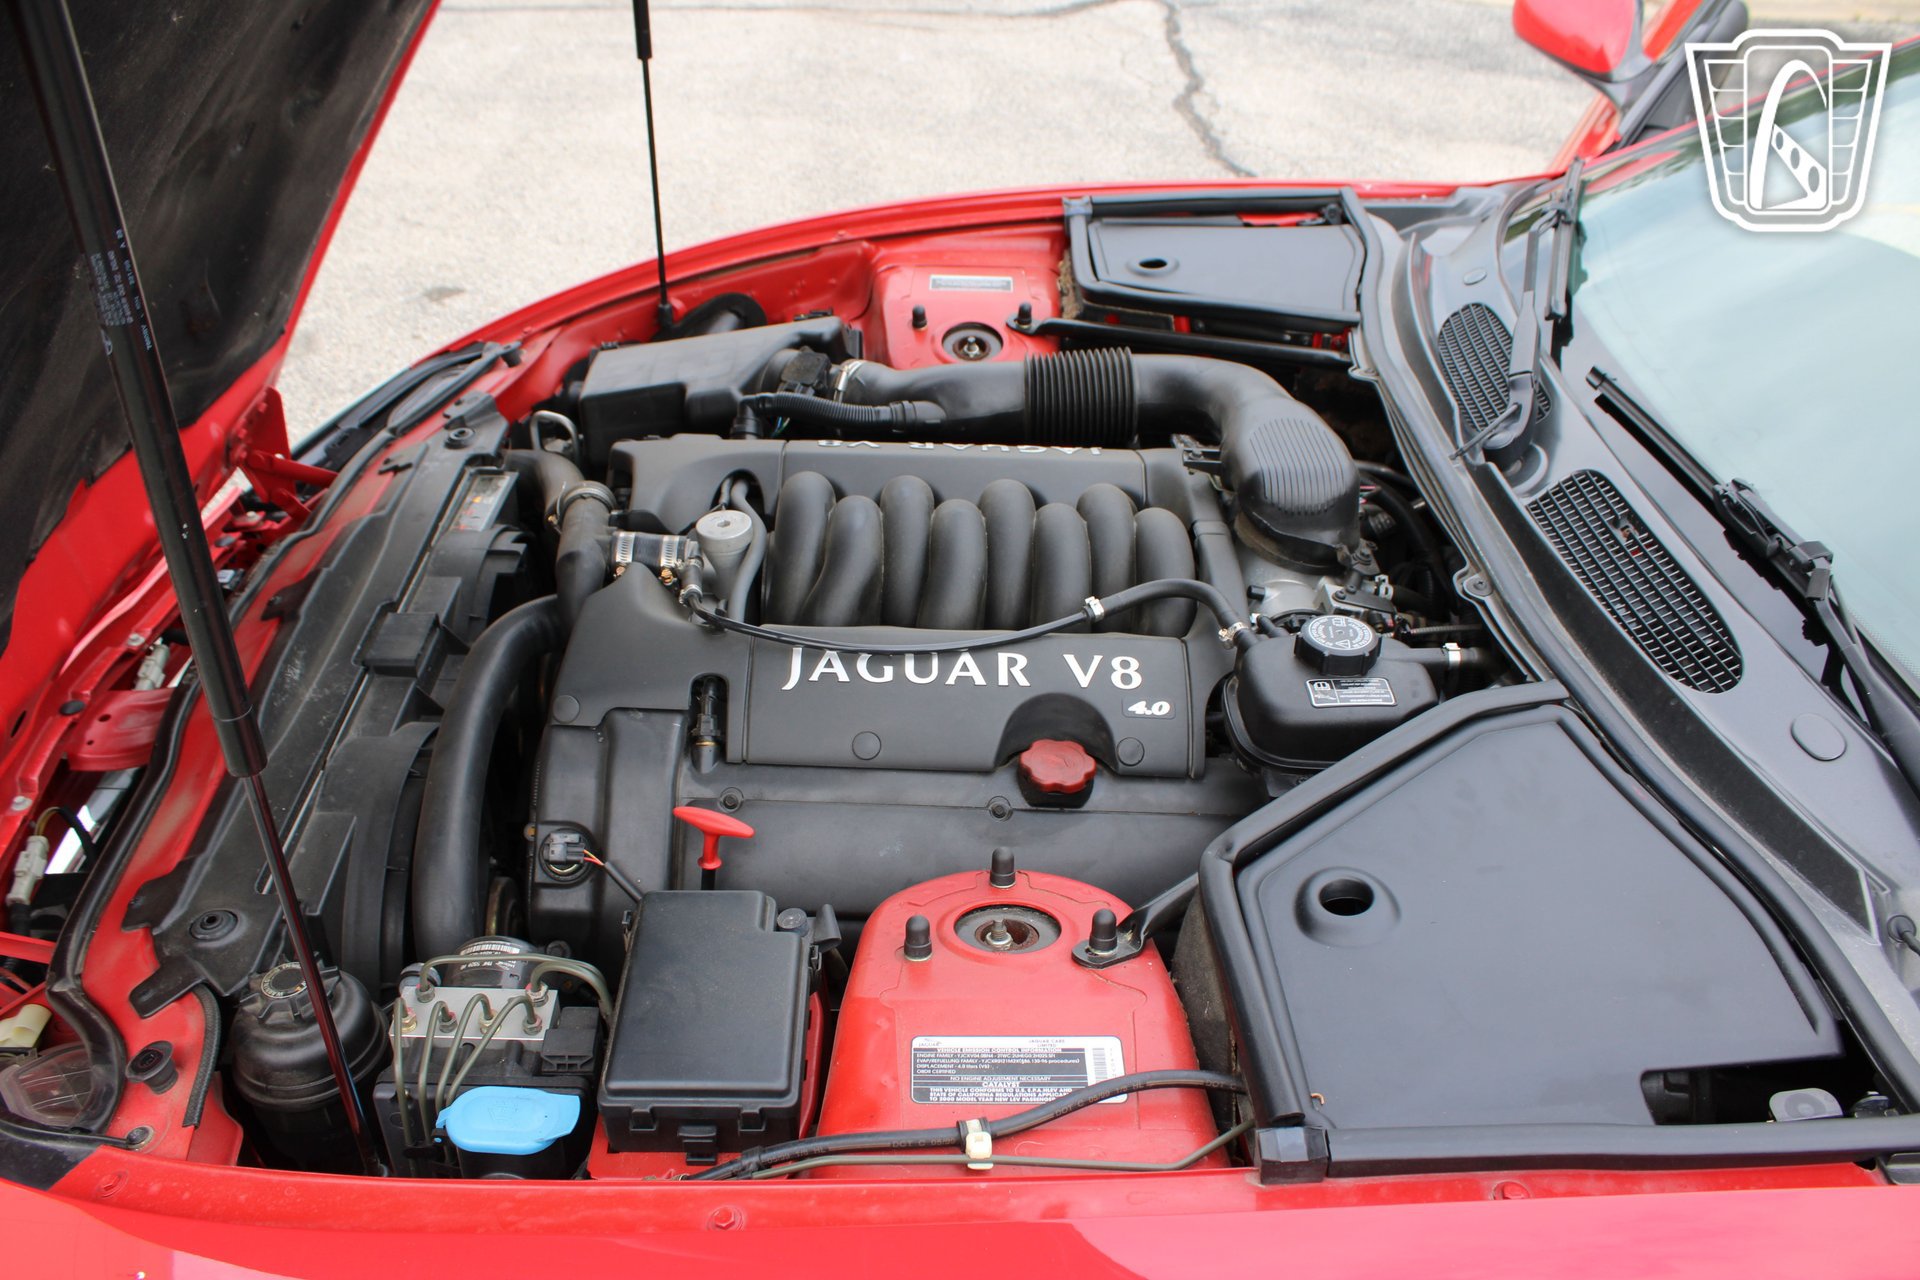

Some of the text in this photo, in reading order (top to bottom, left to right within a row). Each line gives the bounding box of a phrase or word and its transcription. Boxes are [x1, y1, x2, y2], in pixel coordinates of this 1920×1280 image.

[781, 646, 1143, 691] JAGUAR V8
[1126, 700, 1171, 716] 4.0
[1054, 1104, 1075, 1117] DOT
[892, 1140, 914, 1149] DOT
